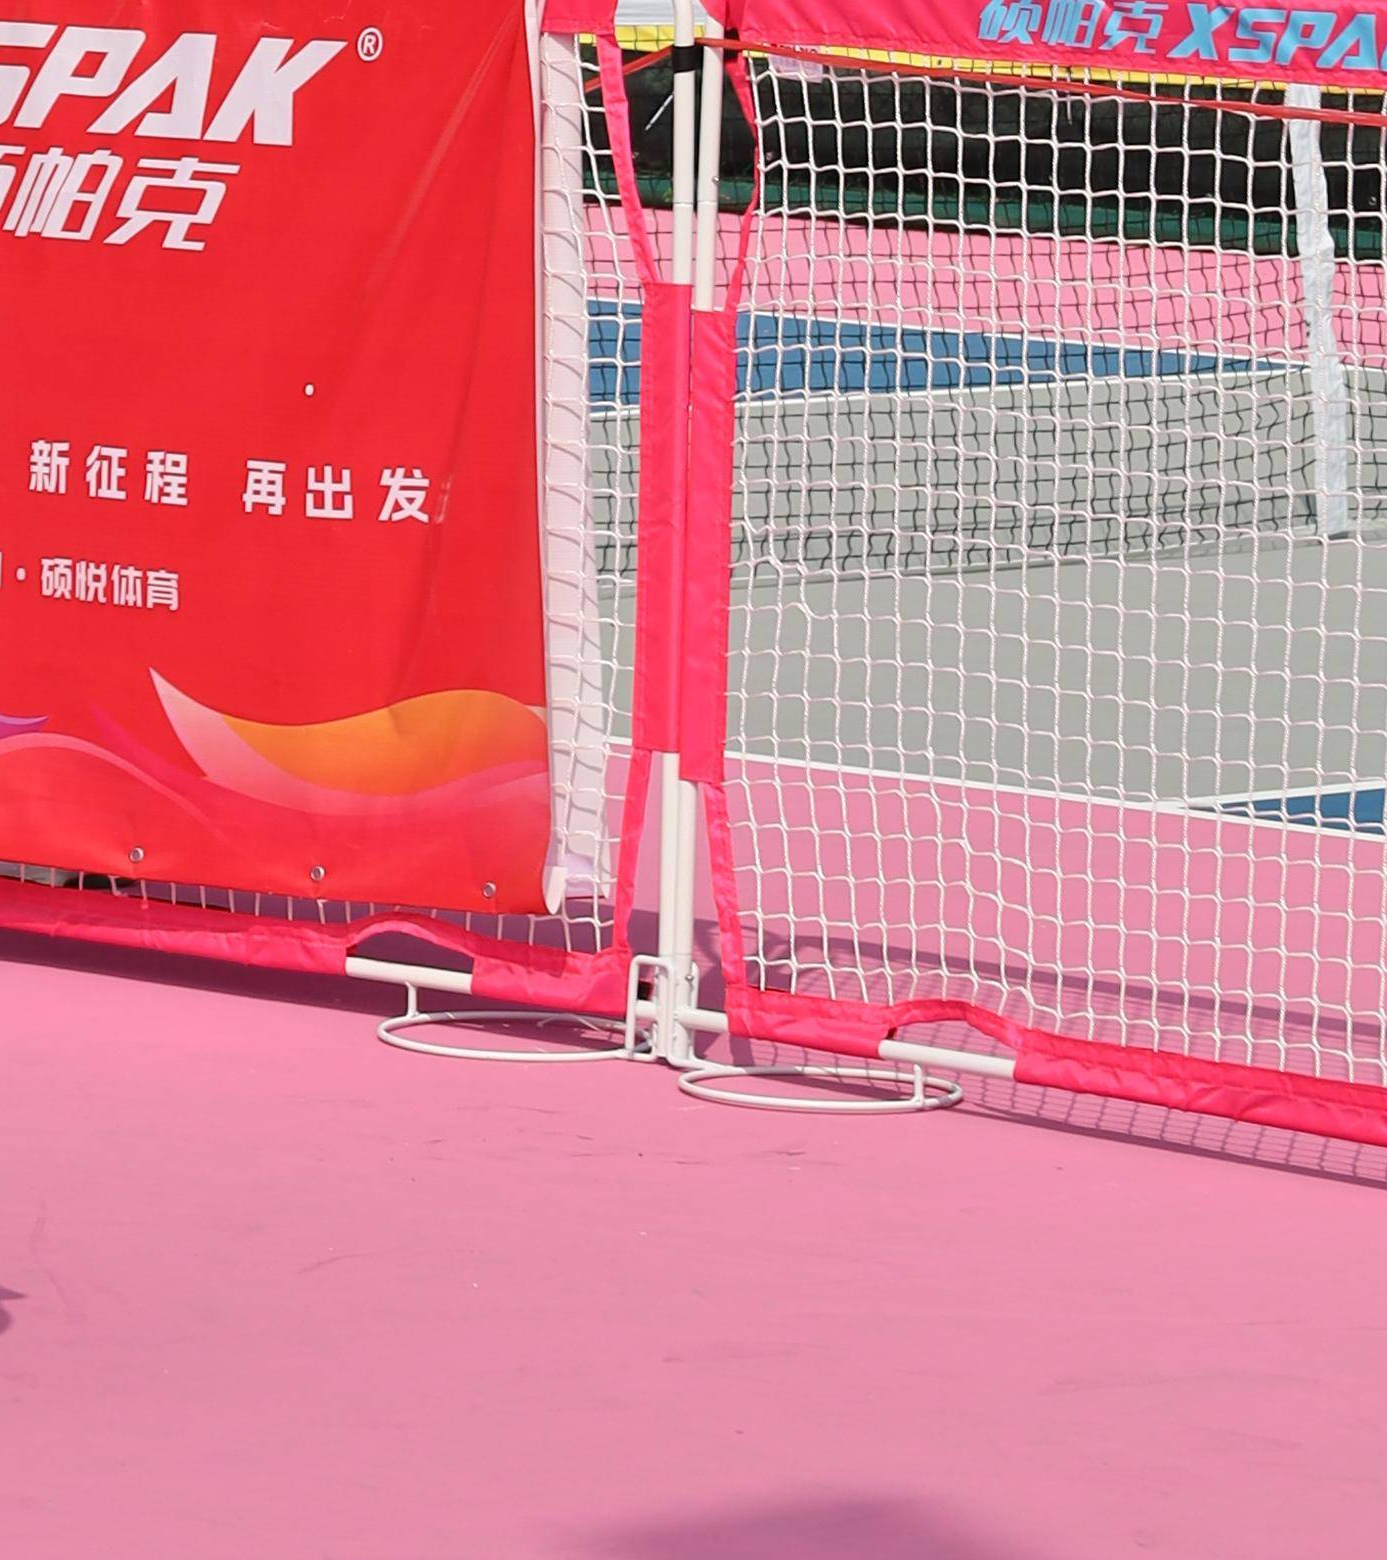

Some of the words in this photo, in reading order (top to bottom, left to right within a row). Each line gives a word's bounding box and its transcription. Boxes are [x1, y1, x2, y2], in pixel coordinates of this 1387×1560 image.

[1165, 1, 1387, 72] XSPA
[28, 439, 190, 507] 新征程
[241, 458, 430, 524] 再出发
